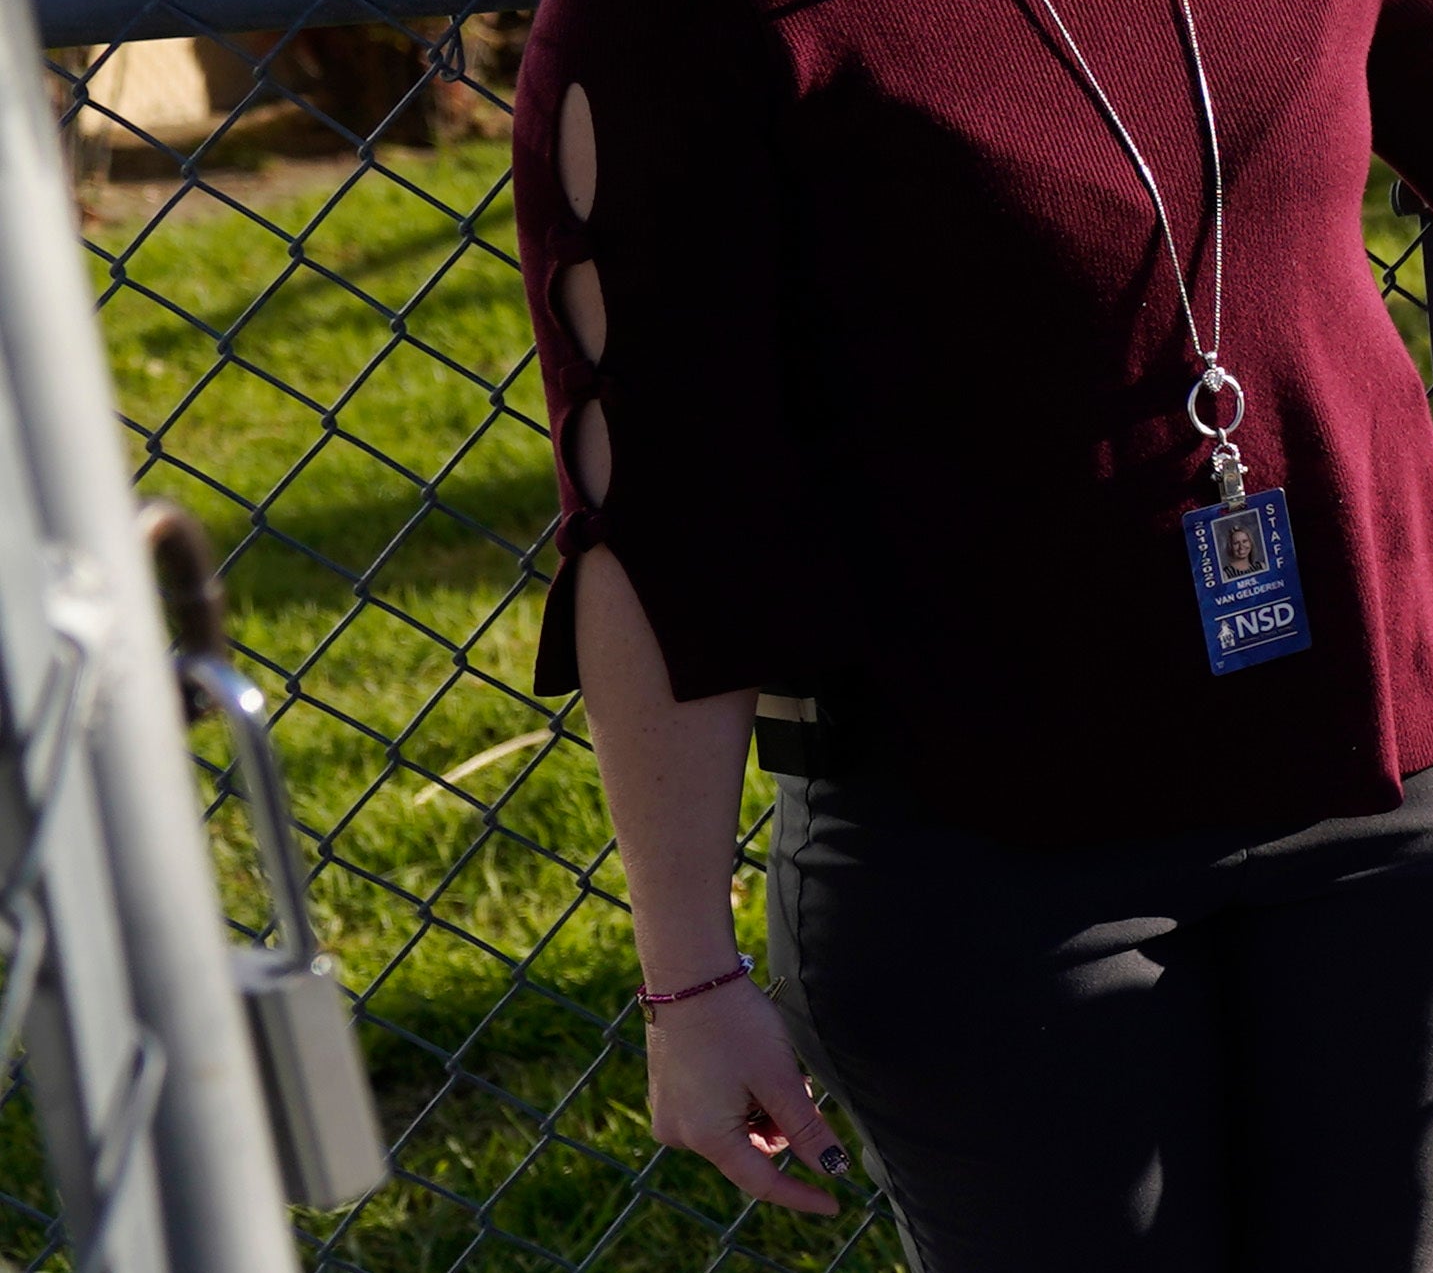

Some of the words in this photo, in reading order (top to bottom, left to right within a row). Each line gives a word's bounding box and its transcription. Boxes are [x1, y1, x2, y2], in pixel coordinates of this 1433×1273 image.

[1265, 503, 1285, 569] STAFF
[1236, 577, 1260, 590] MRS.
[1215, 593, 1236, 607] VAN
[1235, 602, 1295, 638] NSD
